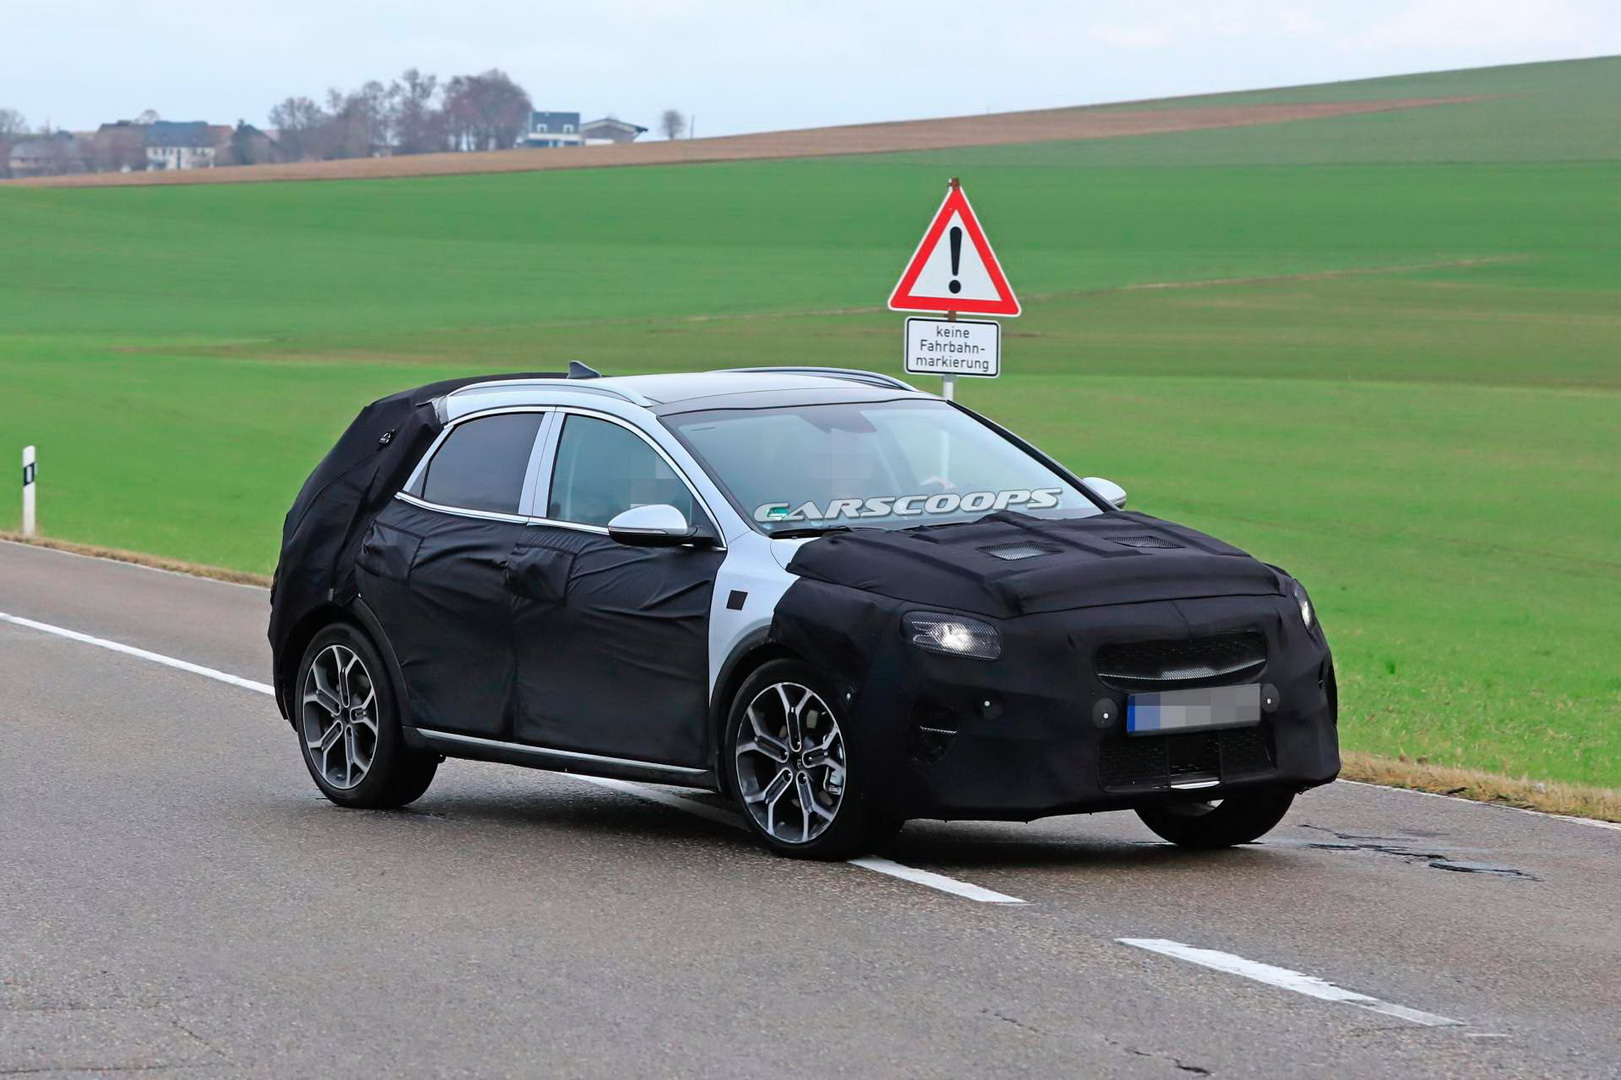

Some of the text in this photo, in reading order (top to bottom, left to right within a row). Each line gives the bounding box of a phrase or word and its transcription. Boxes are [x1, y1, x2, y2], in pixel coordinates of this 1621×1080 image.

[936, 326, 970, 338] keine
[920, 339, 986, 354] Fahrbahn-
[916, 355, 989, 373] markierung
